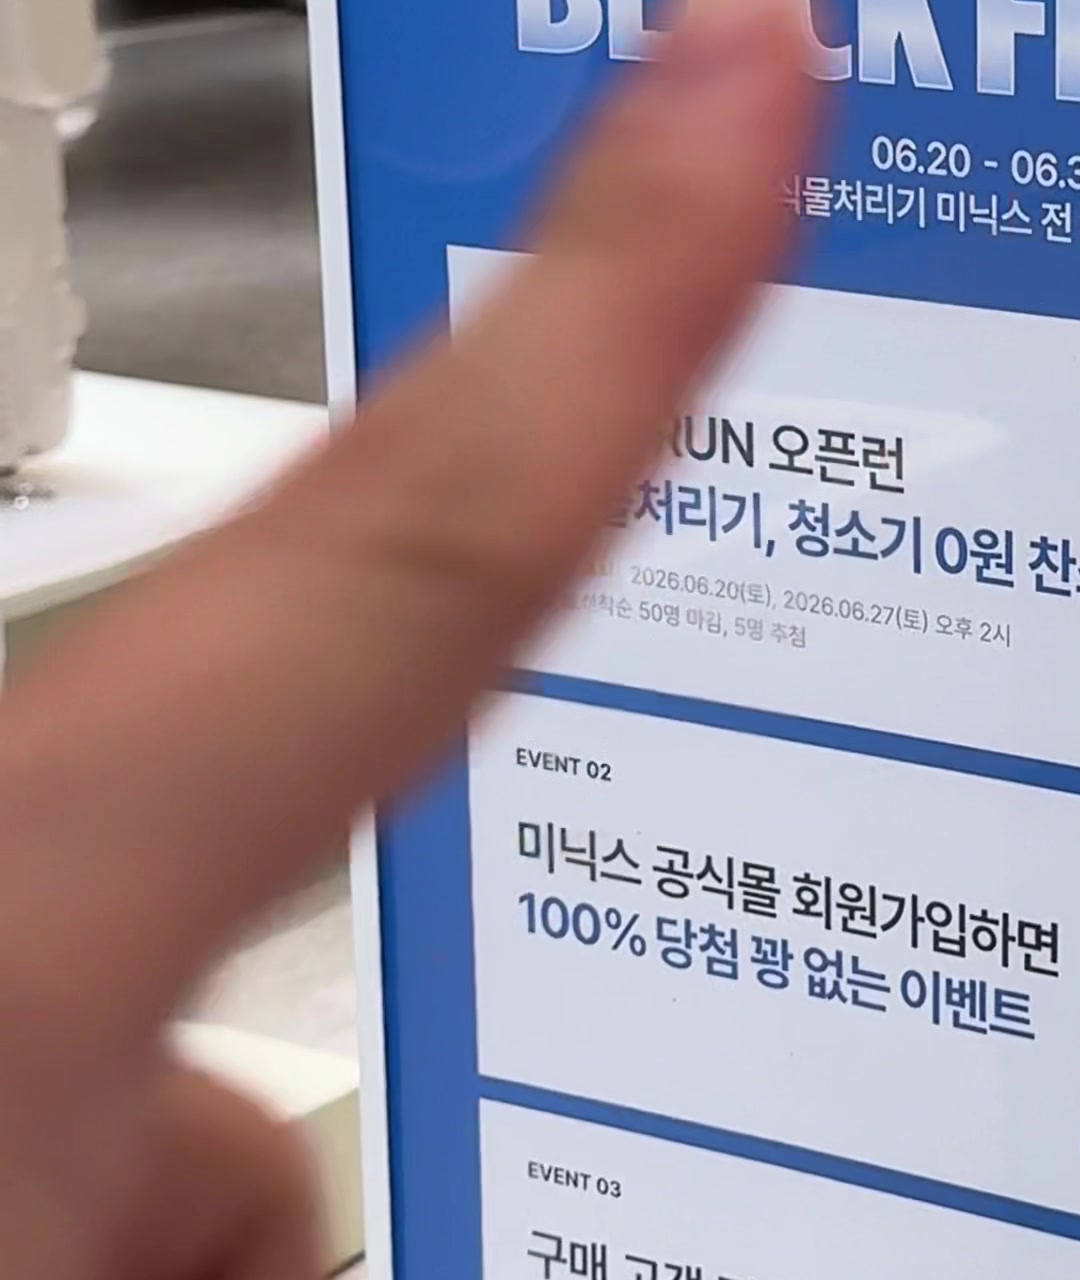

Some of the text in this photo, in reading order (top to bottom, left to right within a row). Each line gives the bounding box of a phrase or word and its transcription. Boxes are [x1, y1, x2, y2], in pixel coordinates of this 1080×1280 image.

[871, 135, 972, 179] 06.20
[936, 190, 1033, 237] 미닉스
[1040, 202, 1073, 244] 전
[769, 425, 905, 494] 오픈런
[788, 499, 922, 575] 청소기
[935, 527, 1015, 589] 0원
[630, 565, 776, 611] 2026.06.20(토),
[783, 590, 929, 635] 2026.06.27(토)
[935, 614, 974, 640] 오후
[980, 622, 1012, 649] 2시
[639, 601, 681, 627] 50명
[686, 607, 729, 638] 마감,
[734, 617, 764, 642] 5명
[770, 622, 808, 649] 추첨
[515, 747, 613, 783] EVENT 02
[517, 821, 1061, 979] 미닉스 공식몰 회원가입하면
[517, 891, 1036, 1040] 100% 당첨 꽝 없는 이벤트
[527, 1161, 622, 1200] EVENT 03
